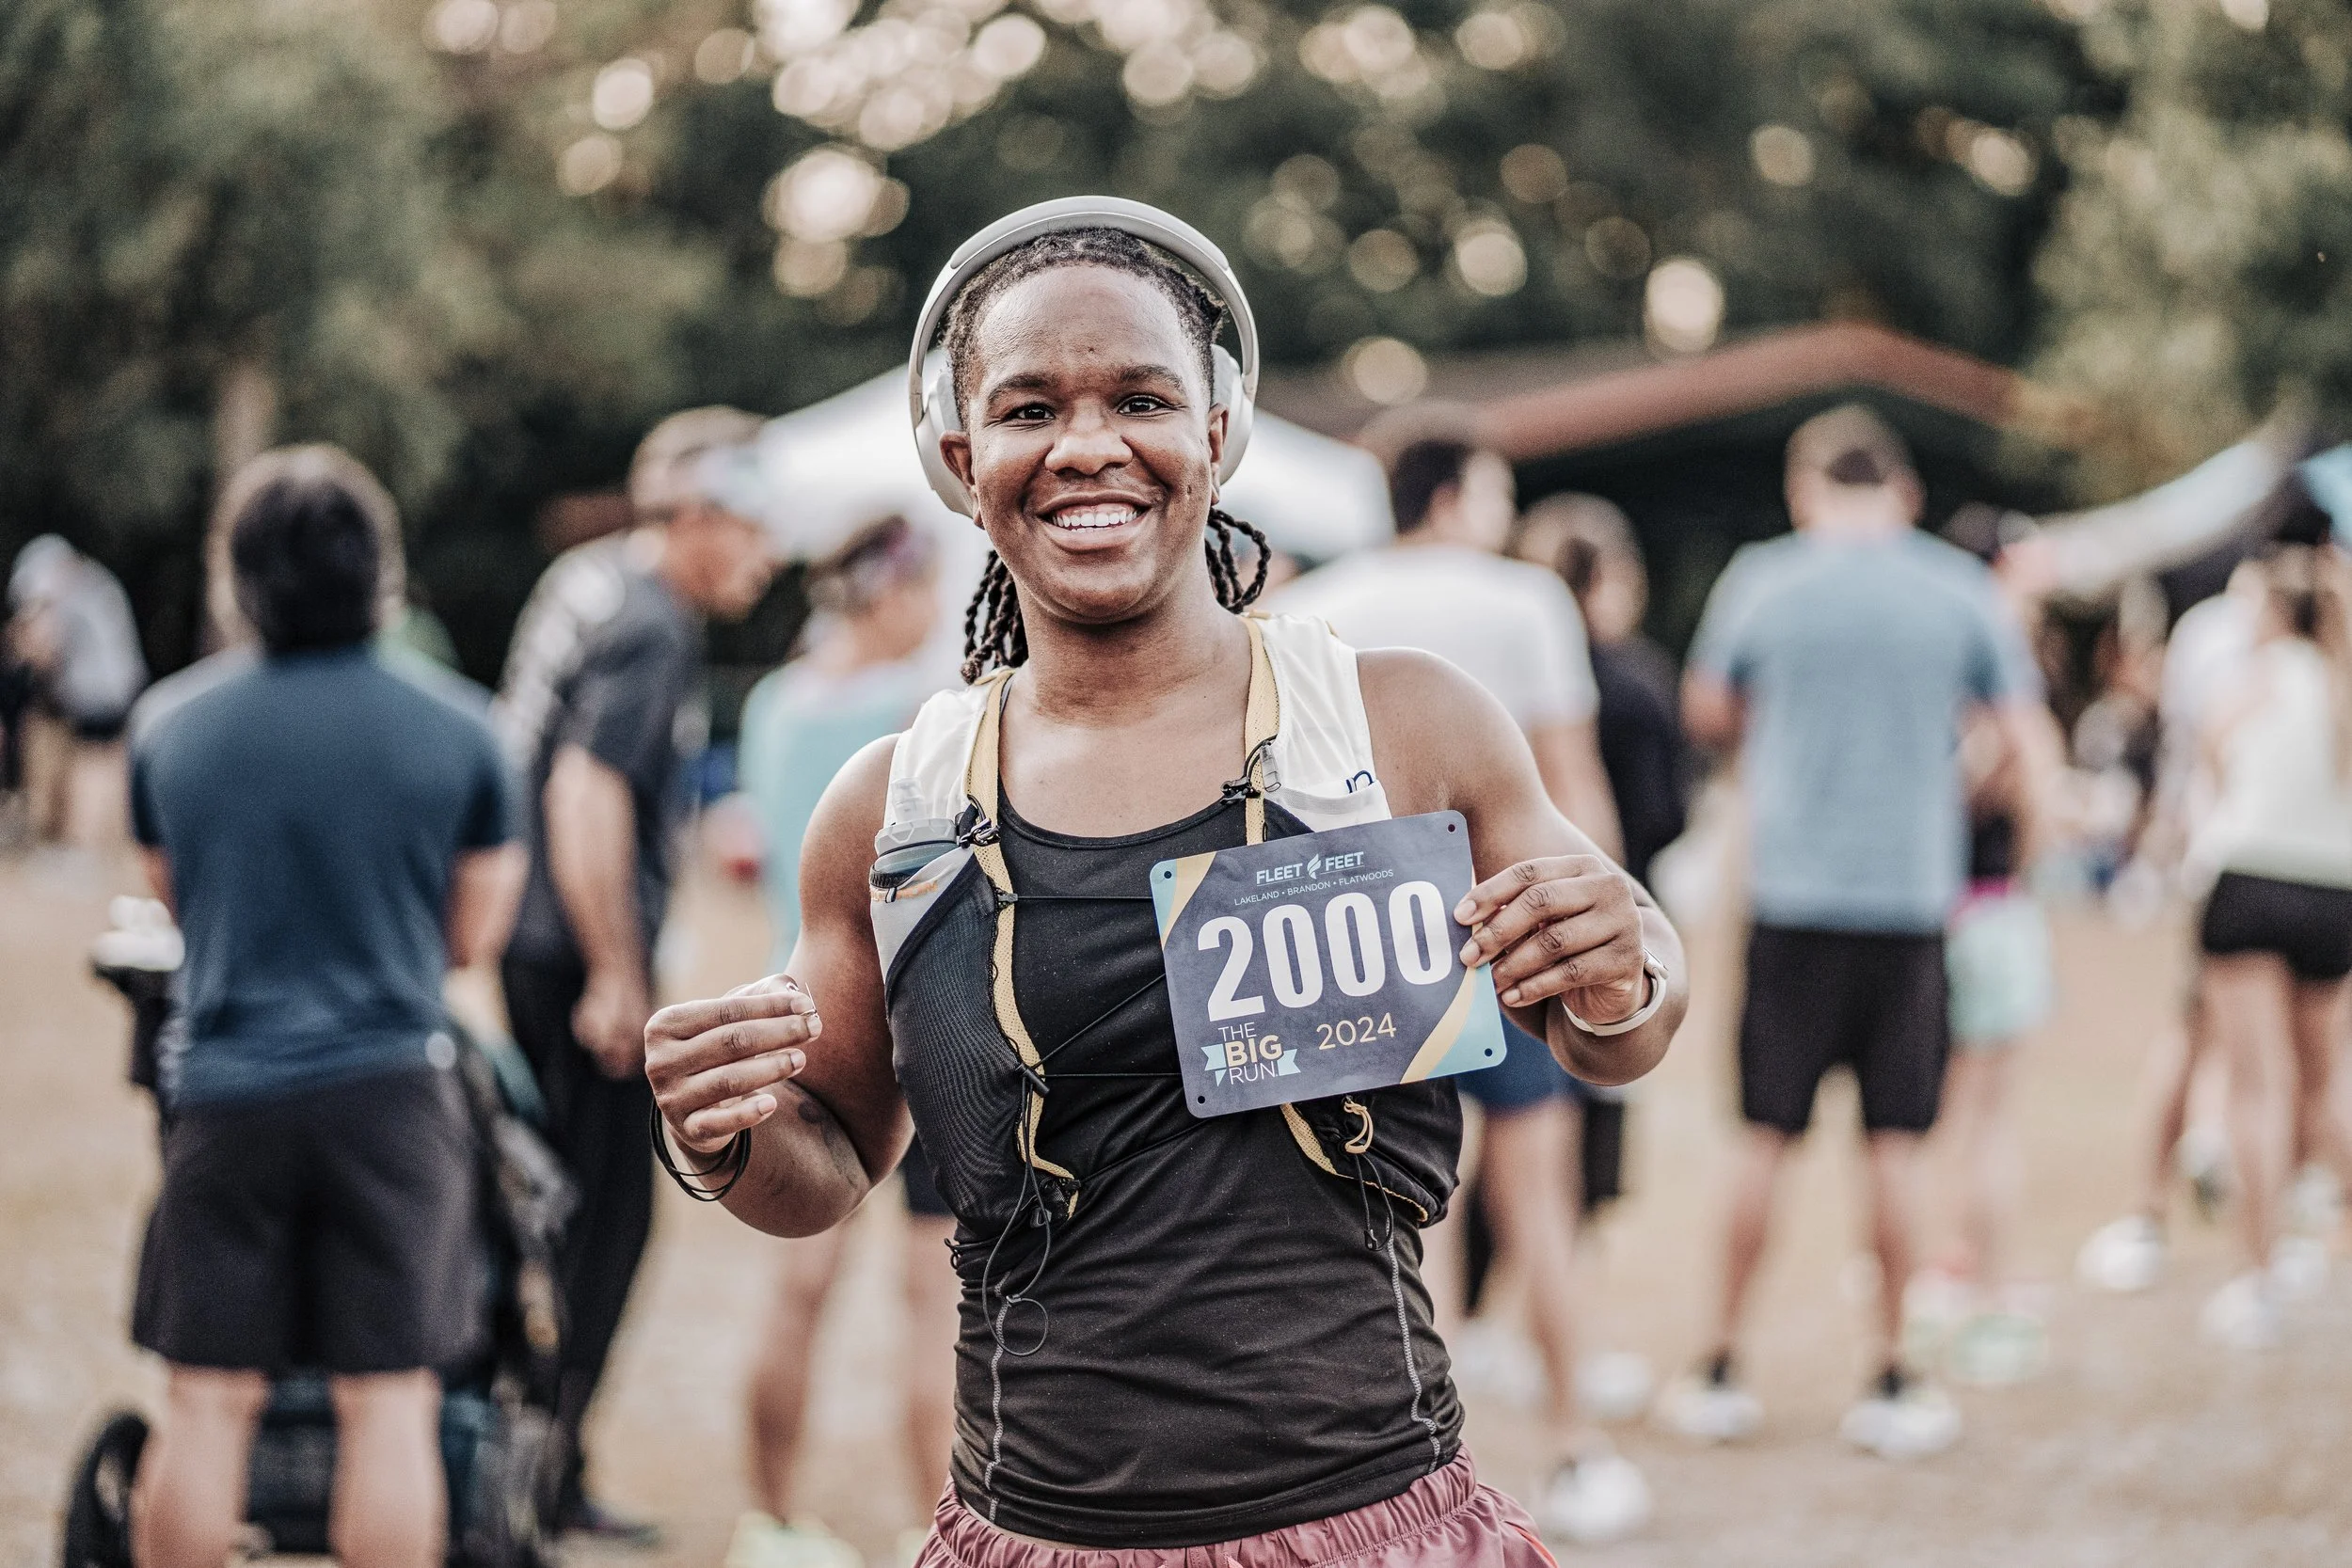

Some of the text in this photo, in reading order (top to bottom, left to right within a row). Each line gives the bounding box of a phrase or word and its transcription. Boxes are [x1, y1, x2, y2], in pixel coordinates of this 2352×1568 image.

[1256, 851, 1364, 885] FLEET FEET
[1233, 869, 1394, 906] LAKELAND BRANDON FLATWOODS
[1197, 880, 1453, 1022] 2000
[1217, 1022, 1257, 1042] THE
[1316, 1012, 1397, 1051] 2024
[1225, 1035, 1282, 1068] BIG
[1229, 1061, 1277, 1085] RUN
